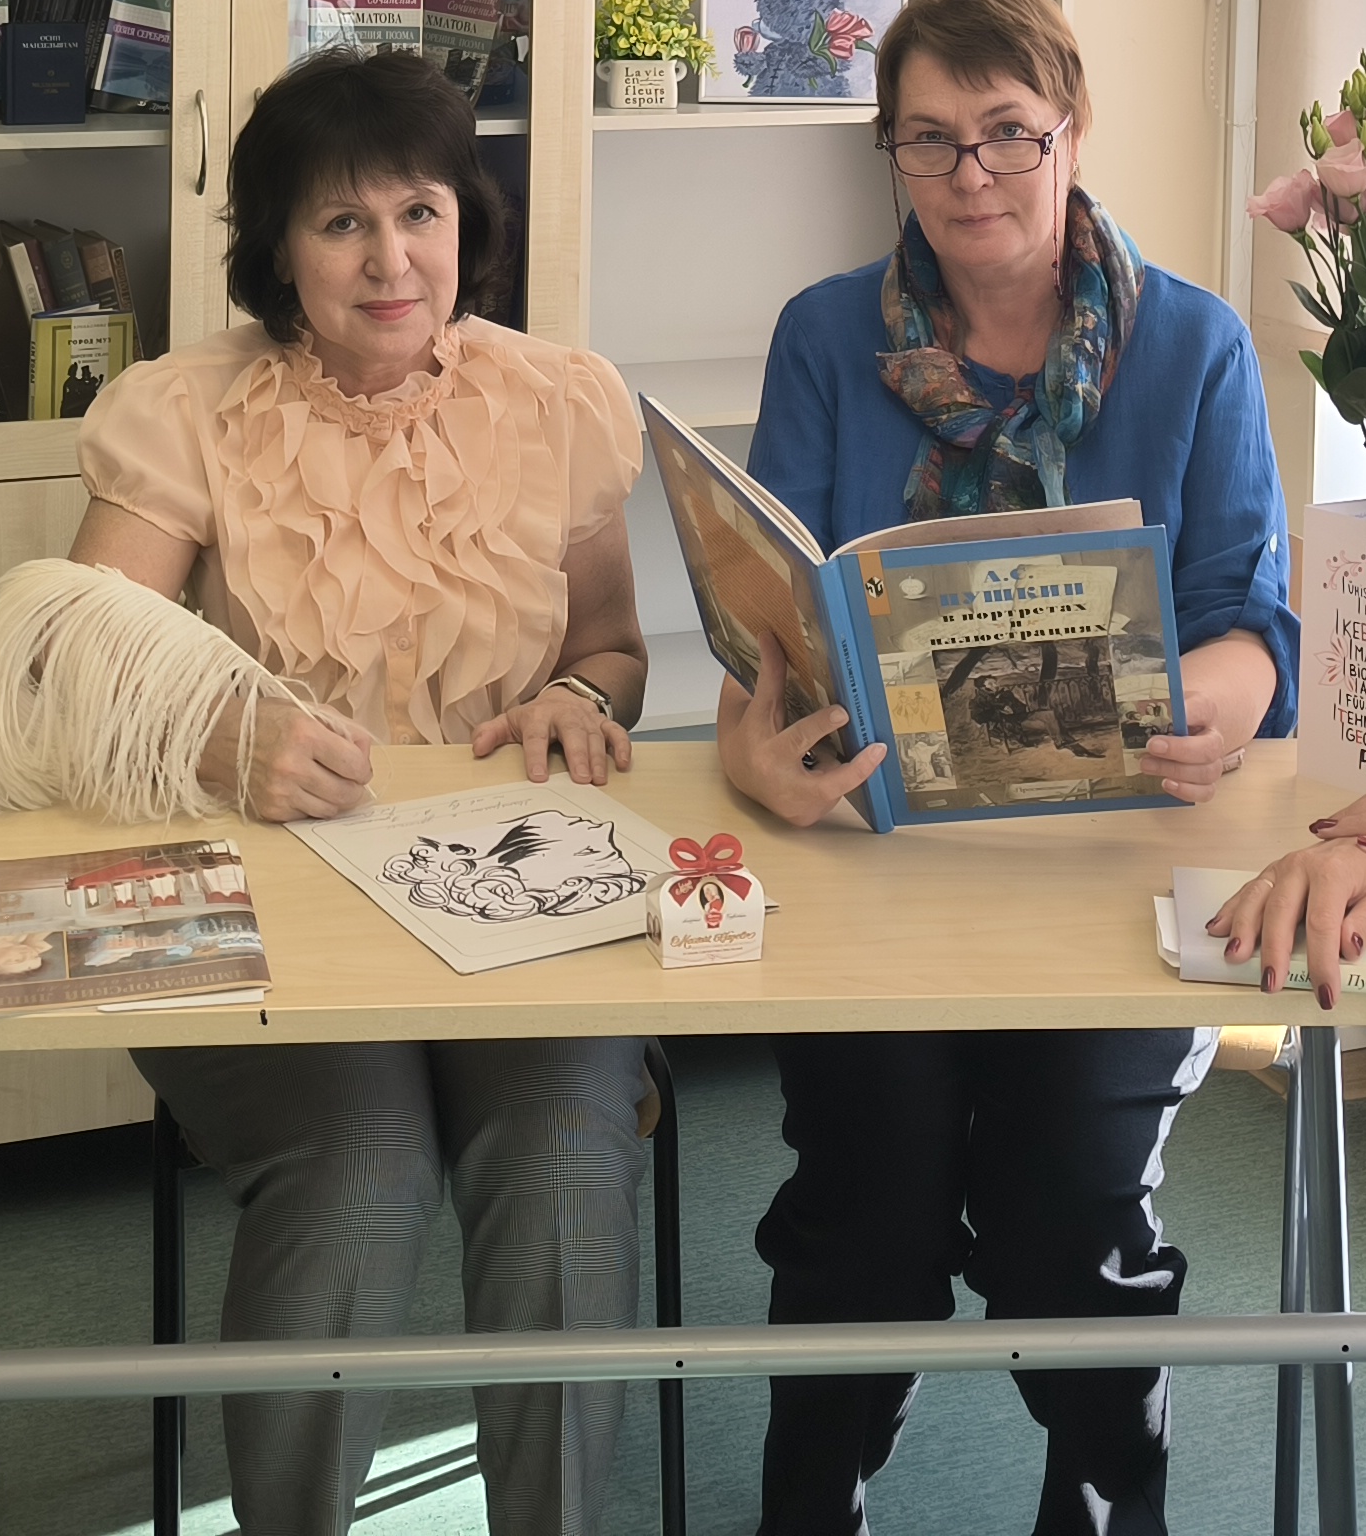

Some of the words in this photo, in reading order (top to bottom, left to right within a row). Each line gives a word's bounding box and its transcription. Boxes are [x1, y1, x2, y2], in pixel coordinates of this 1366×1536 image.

[625, 67, 641, 77] La
[645, 67, 665, 77] vie
[625, 85, 665, 95] fleurs
[625, 97, 665, 107] espoir
[984, 567, 1034, 583] А.С.
[940, 583, 1084, 607] ПУШКИН
